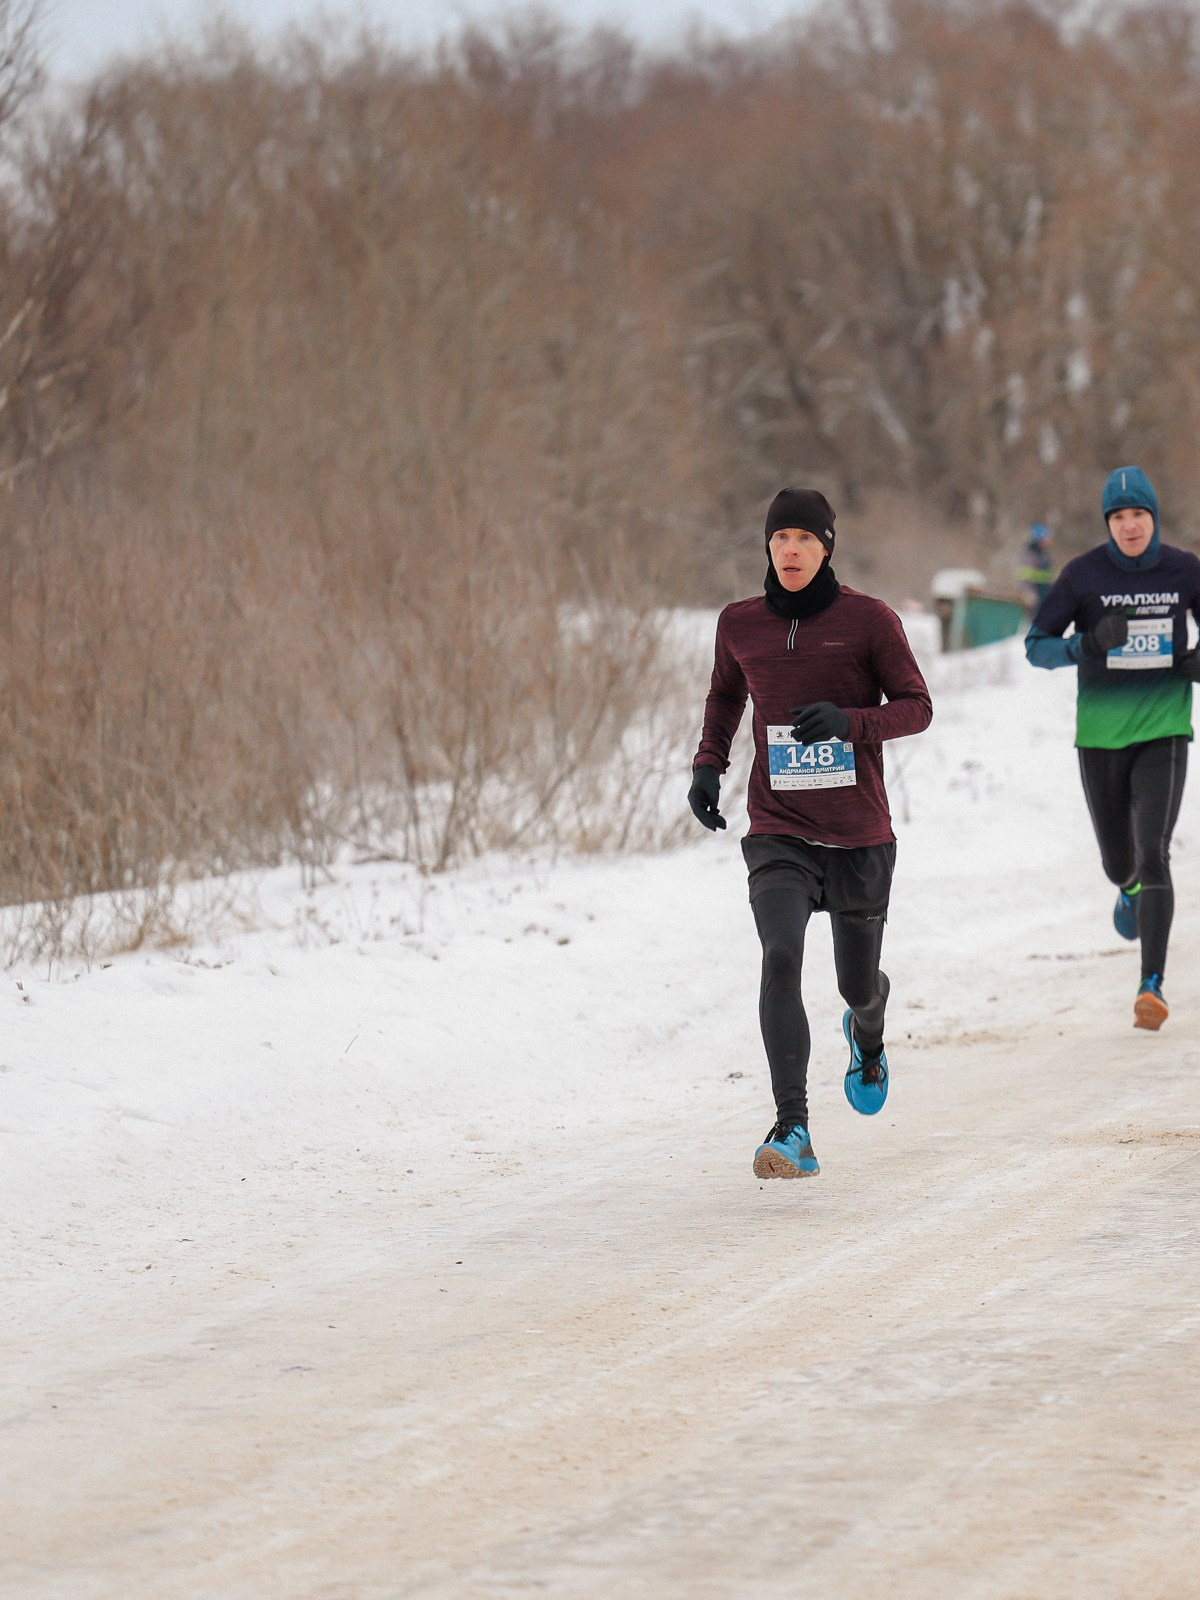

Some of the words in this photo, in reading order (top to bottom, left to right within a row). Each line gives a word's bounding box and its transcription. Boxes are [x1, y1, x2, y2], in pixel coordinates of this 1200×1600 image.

[1100, 592, 1179, 607] УРАЛХИМ
[1122, 635, 1160, 652] 208
[786, 745, 835, 768] 148
[779, 767, 815, 775] АНДРИАНОВ
[815, 764, 845, 774] ДМИТРИЙ
